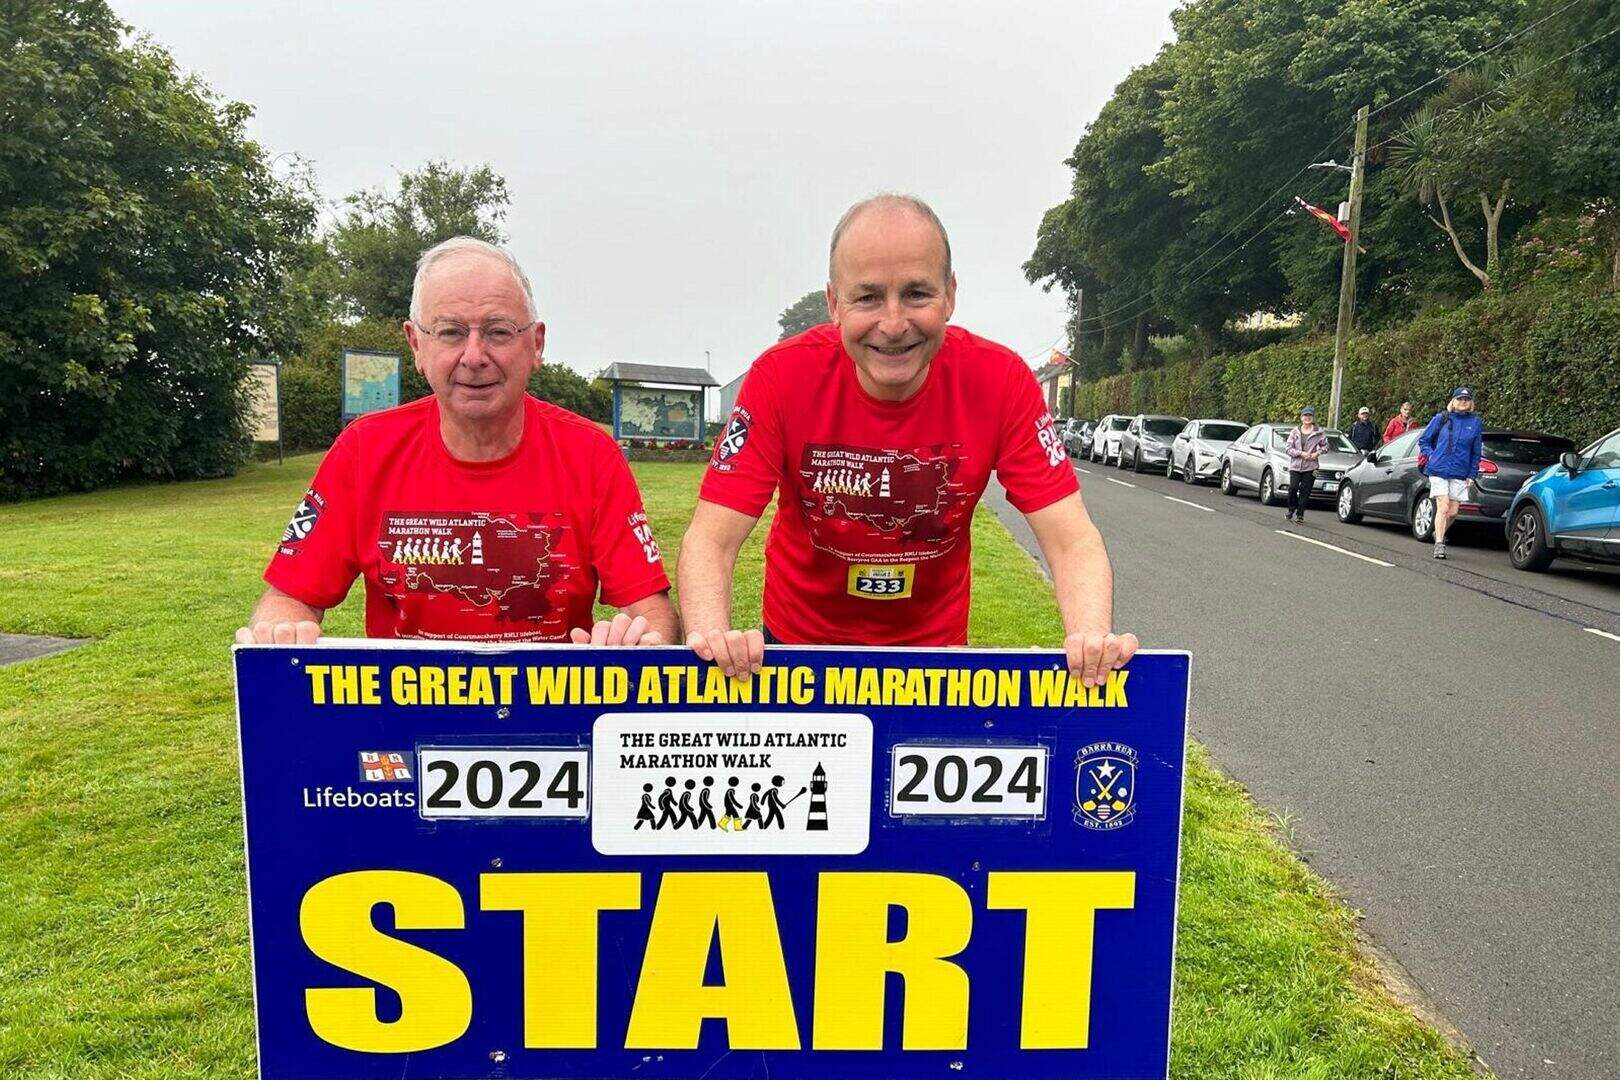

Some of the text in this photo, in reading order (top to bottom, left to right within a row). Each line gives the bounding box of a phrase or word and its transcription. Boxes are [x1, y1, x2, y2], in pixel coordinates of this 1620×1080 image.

[811, 459, 864, 470] MARATHON WALK
[812, 450, 826, 458] THE
[861, 454, 895, 464] ATLANTIC
[389, 518, 405, 526] THE
[405, 518, 427, 526] GREAT
[448, 519, 486, 527] ATLANTIC
[389, 527, 453, 536] MARATHON WALK
[860, 578, 901, 593] 233
[305, 665, 1130, 708] THE GREAT WILD ATLANTIC MARATHON WALK
[620, 733, 848, 748] THE GREAT WILD ATLANTIC
[620, 754, 771, 769] MARATHON WALK
[426, 760, 584, 810] 2024
[896, 755, 1042, 804] 2024
[303, 786, 416, 808] Lifeboats
[299, 868, 1136, 1054] START
